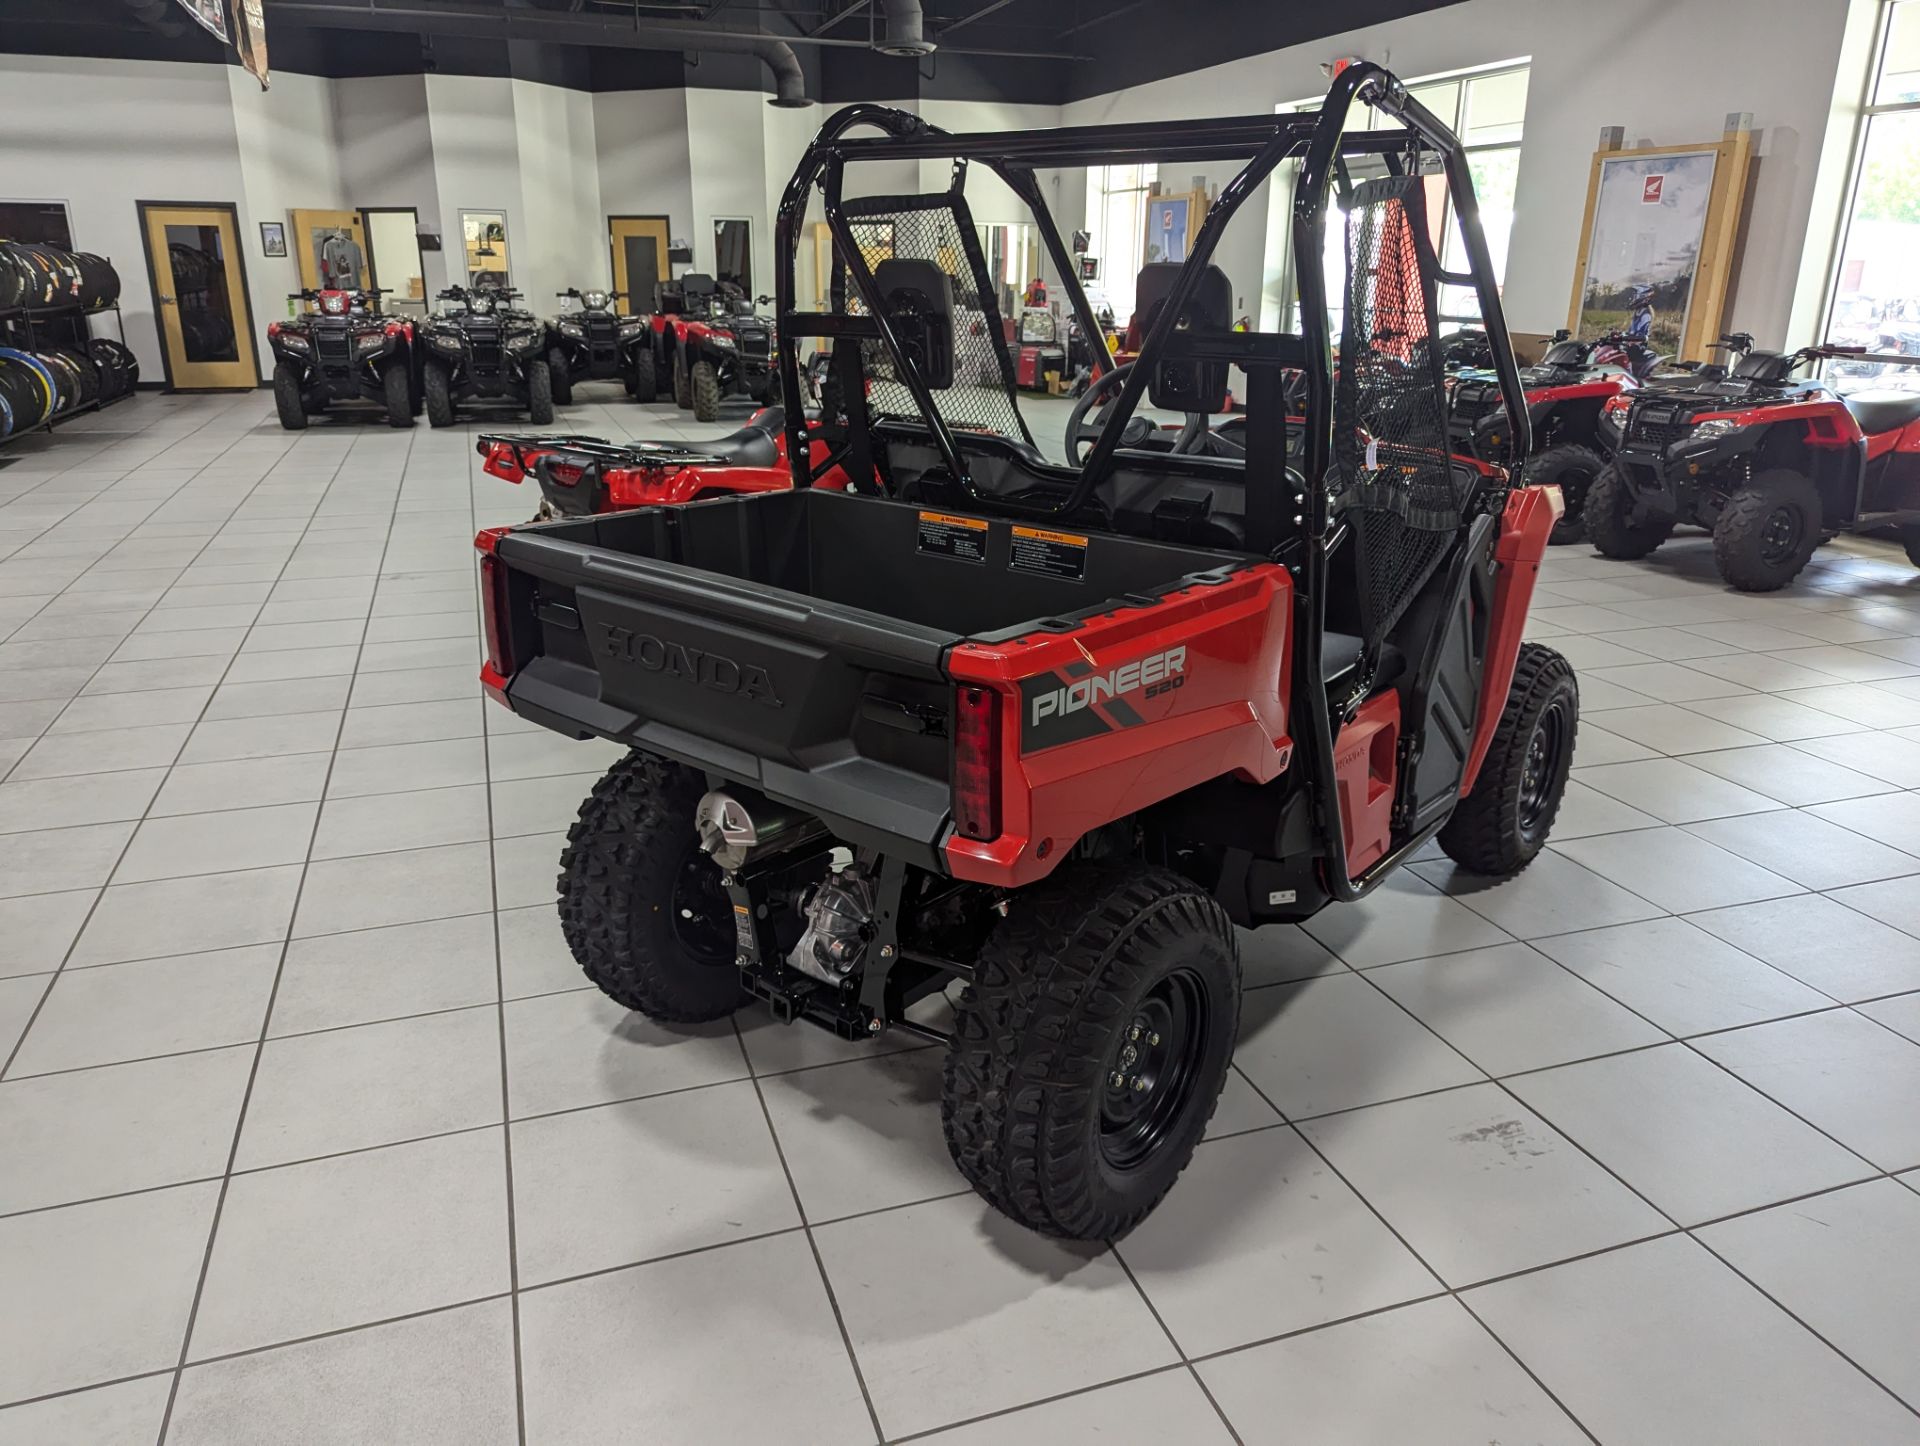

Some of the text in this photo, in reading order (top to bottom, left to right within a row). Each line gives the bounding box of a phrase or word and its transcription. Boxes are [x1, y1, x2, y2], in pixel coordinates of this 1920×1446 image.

[1040, 532, 1064, 541] WARNING
[599, 622, 784, 708] HONDA
[1032, 645, 1186, 727] PIONEER
[1145, 675, 1184, 700] 520
